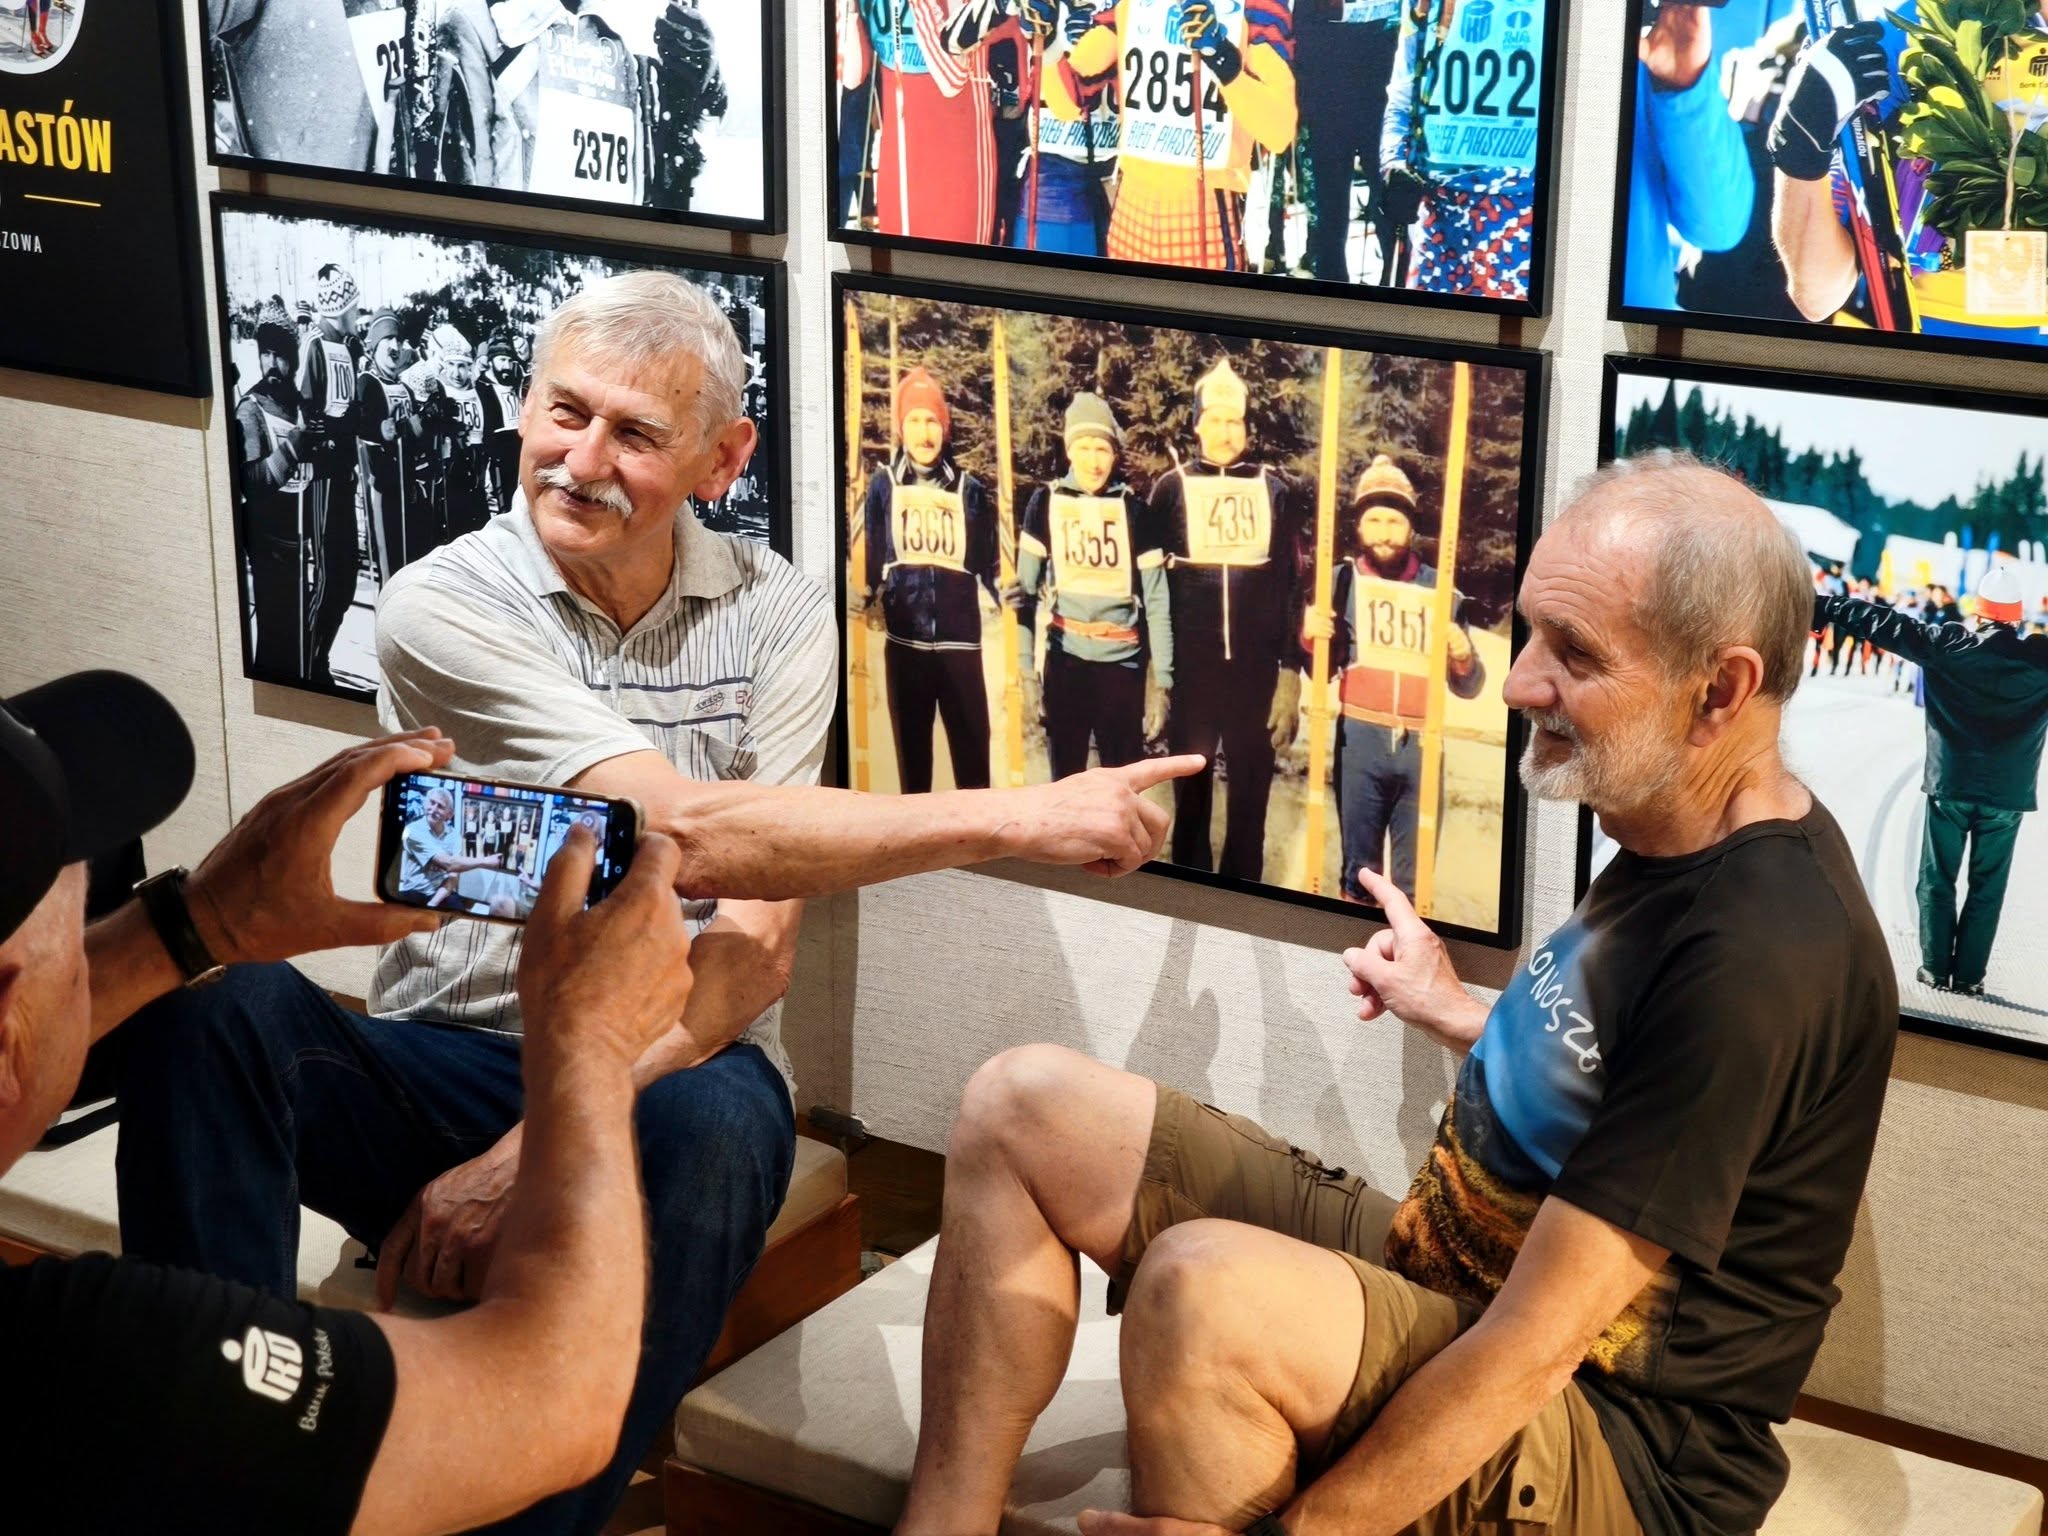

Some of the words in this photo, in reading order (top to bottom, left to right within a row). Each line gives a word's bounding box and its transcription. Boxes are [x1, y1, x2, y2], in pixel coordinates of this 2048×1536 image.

[1125, 47, 1228, 122] 2854
[1422, 48, 1536, 118] 2022
[0, 99, 111, 173] ASTÓW
[573, 128, 628, 185] 2378
[0, 230, 43, 254] ZOWA
[901, 508, 956, 557] 1360
[1062, 519, 1119, 568] 1355
[1208, 495, 1256, 543] 439
[299, 1383, 330, 1432] Bank
